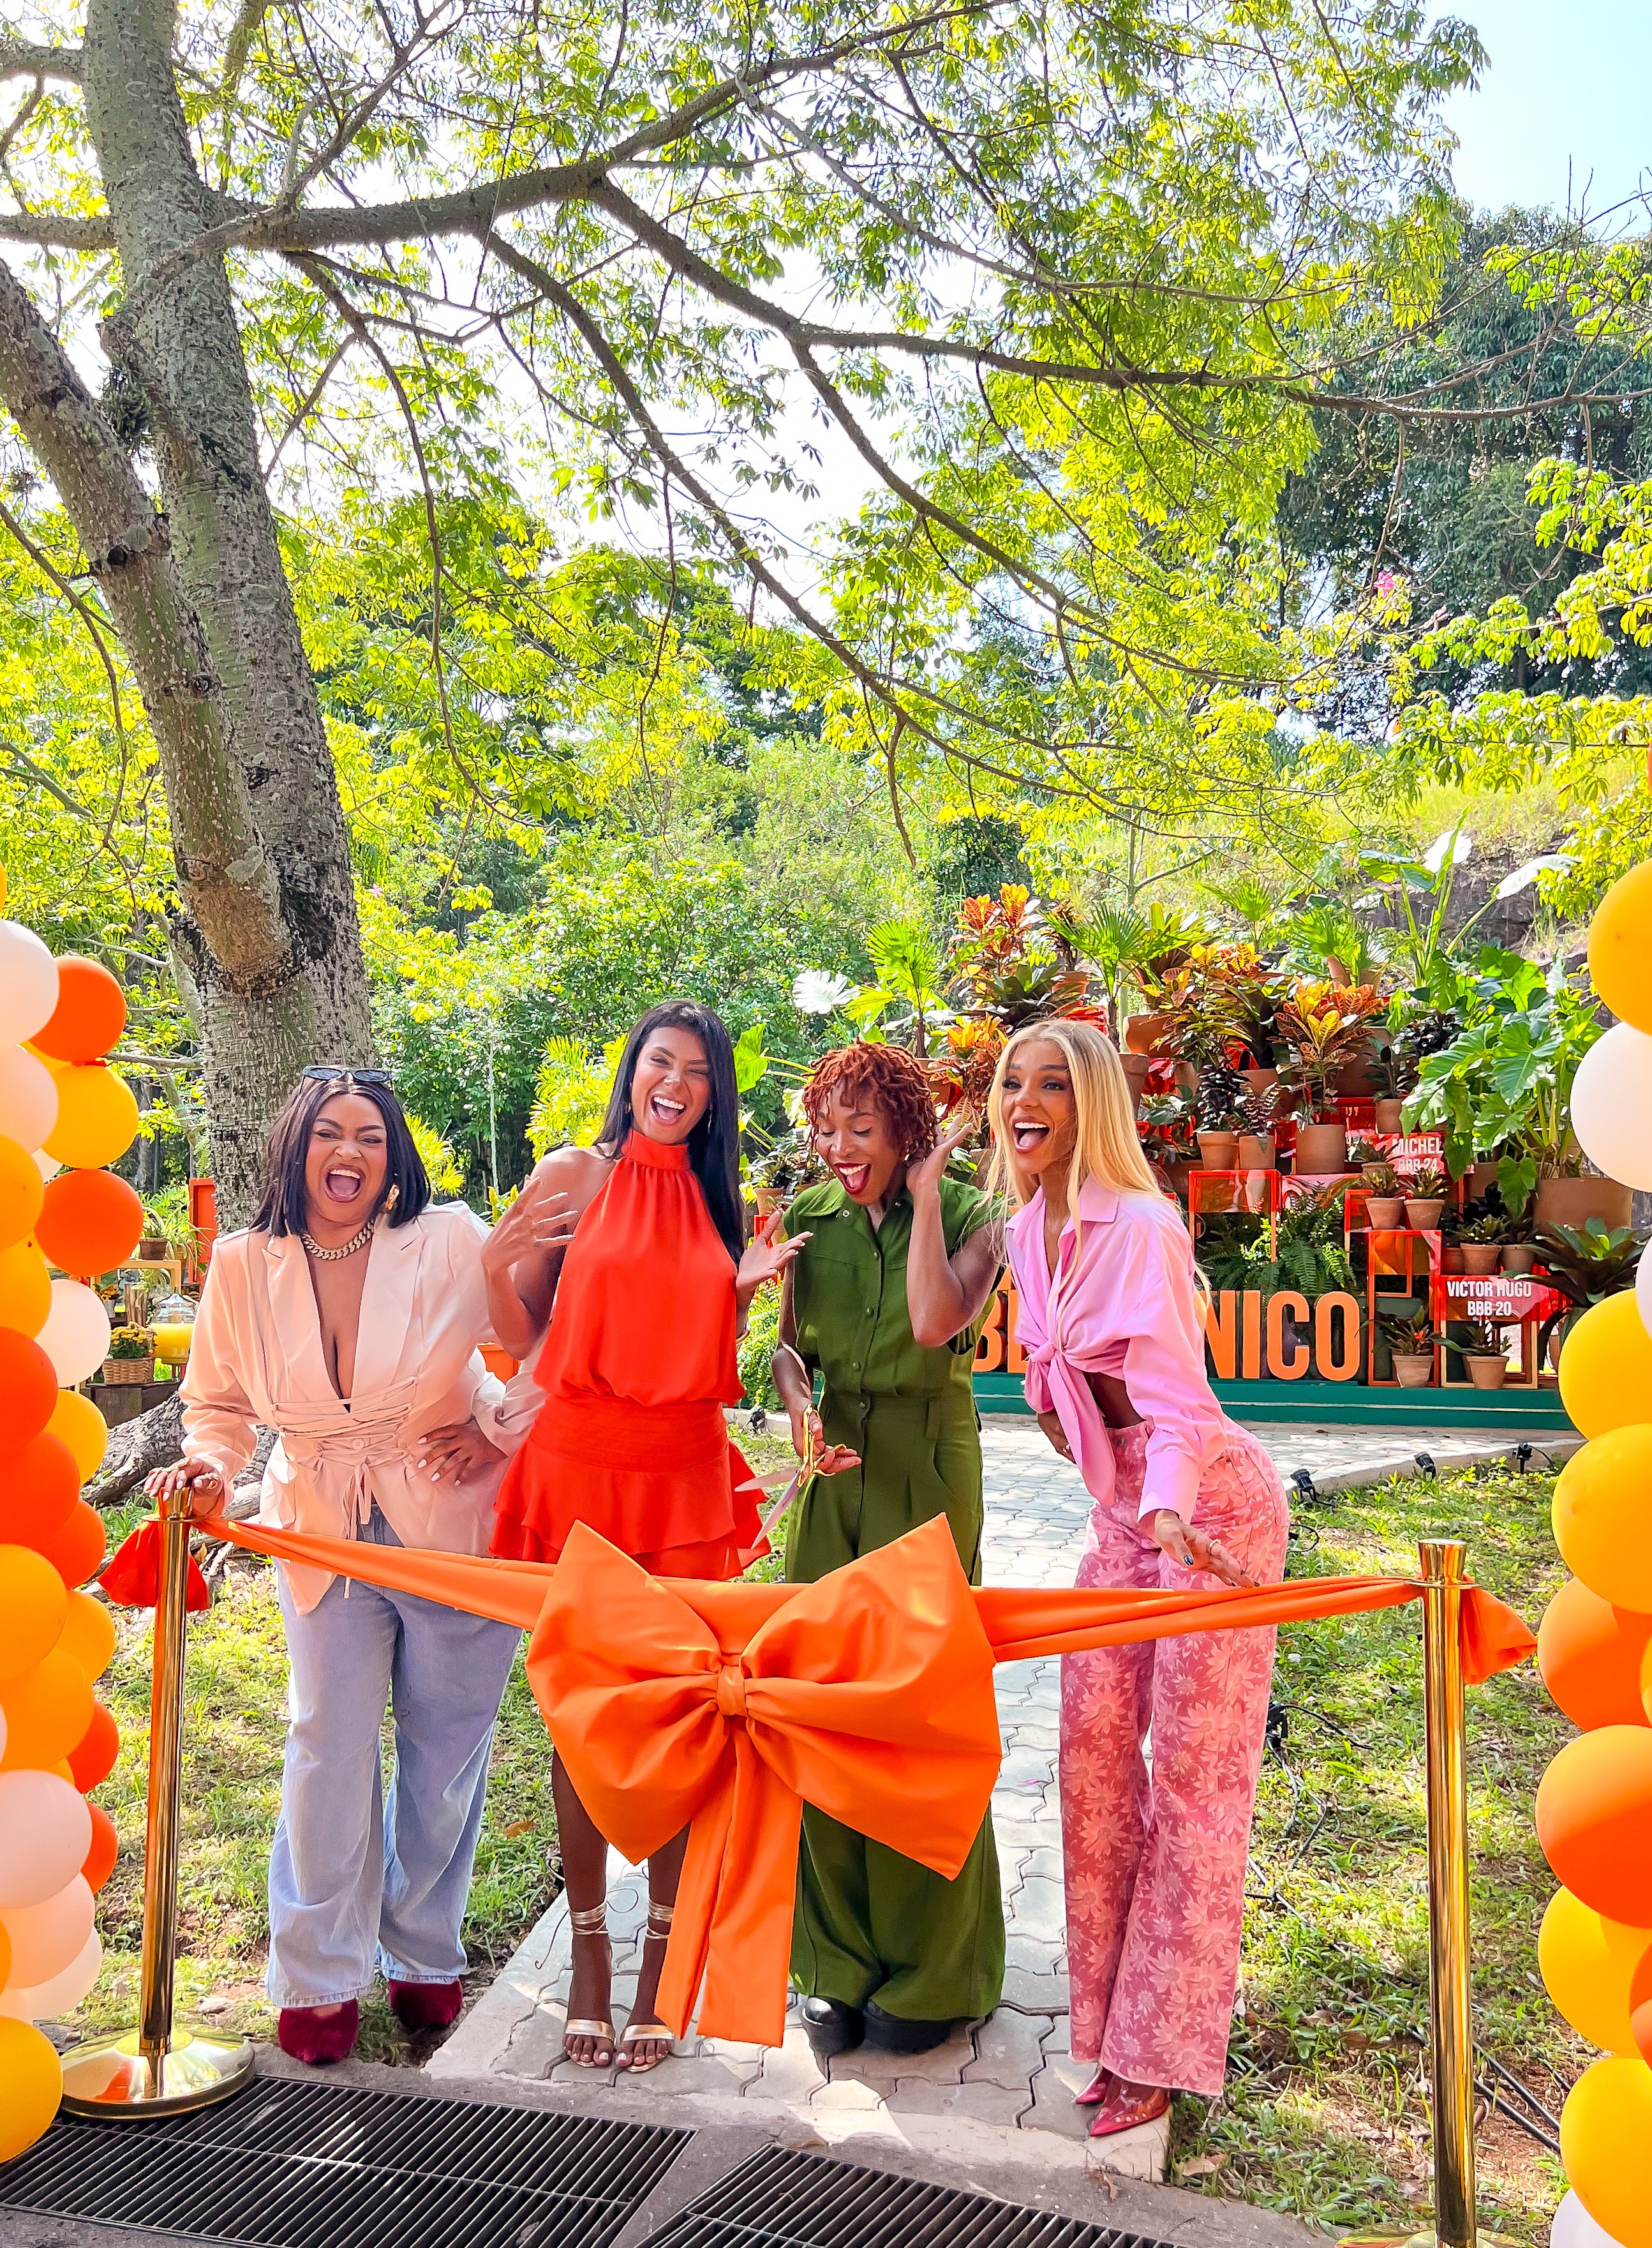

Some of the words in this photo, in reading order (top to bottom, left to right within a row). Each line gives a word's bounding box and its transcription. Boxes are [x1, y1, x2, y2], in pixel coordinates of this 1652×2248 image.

[1392, 1137, 1444, 1154] MICHEL
[1423, 1158, 1438, 1172] 24
[1447, 1281, 1493, 1297] VICTOR
[1496, 1282, 1531, 1297] HUGO
[1467, 1301, 1492, 1316] BBB
[1495, 1301, 1512, 1316] 20
